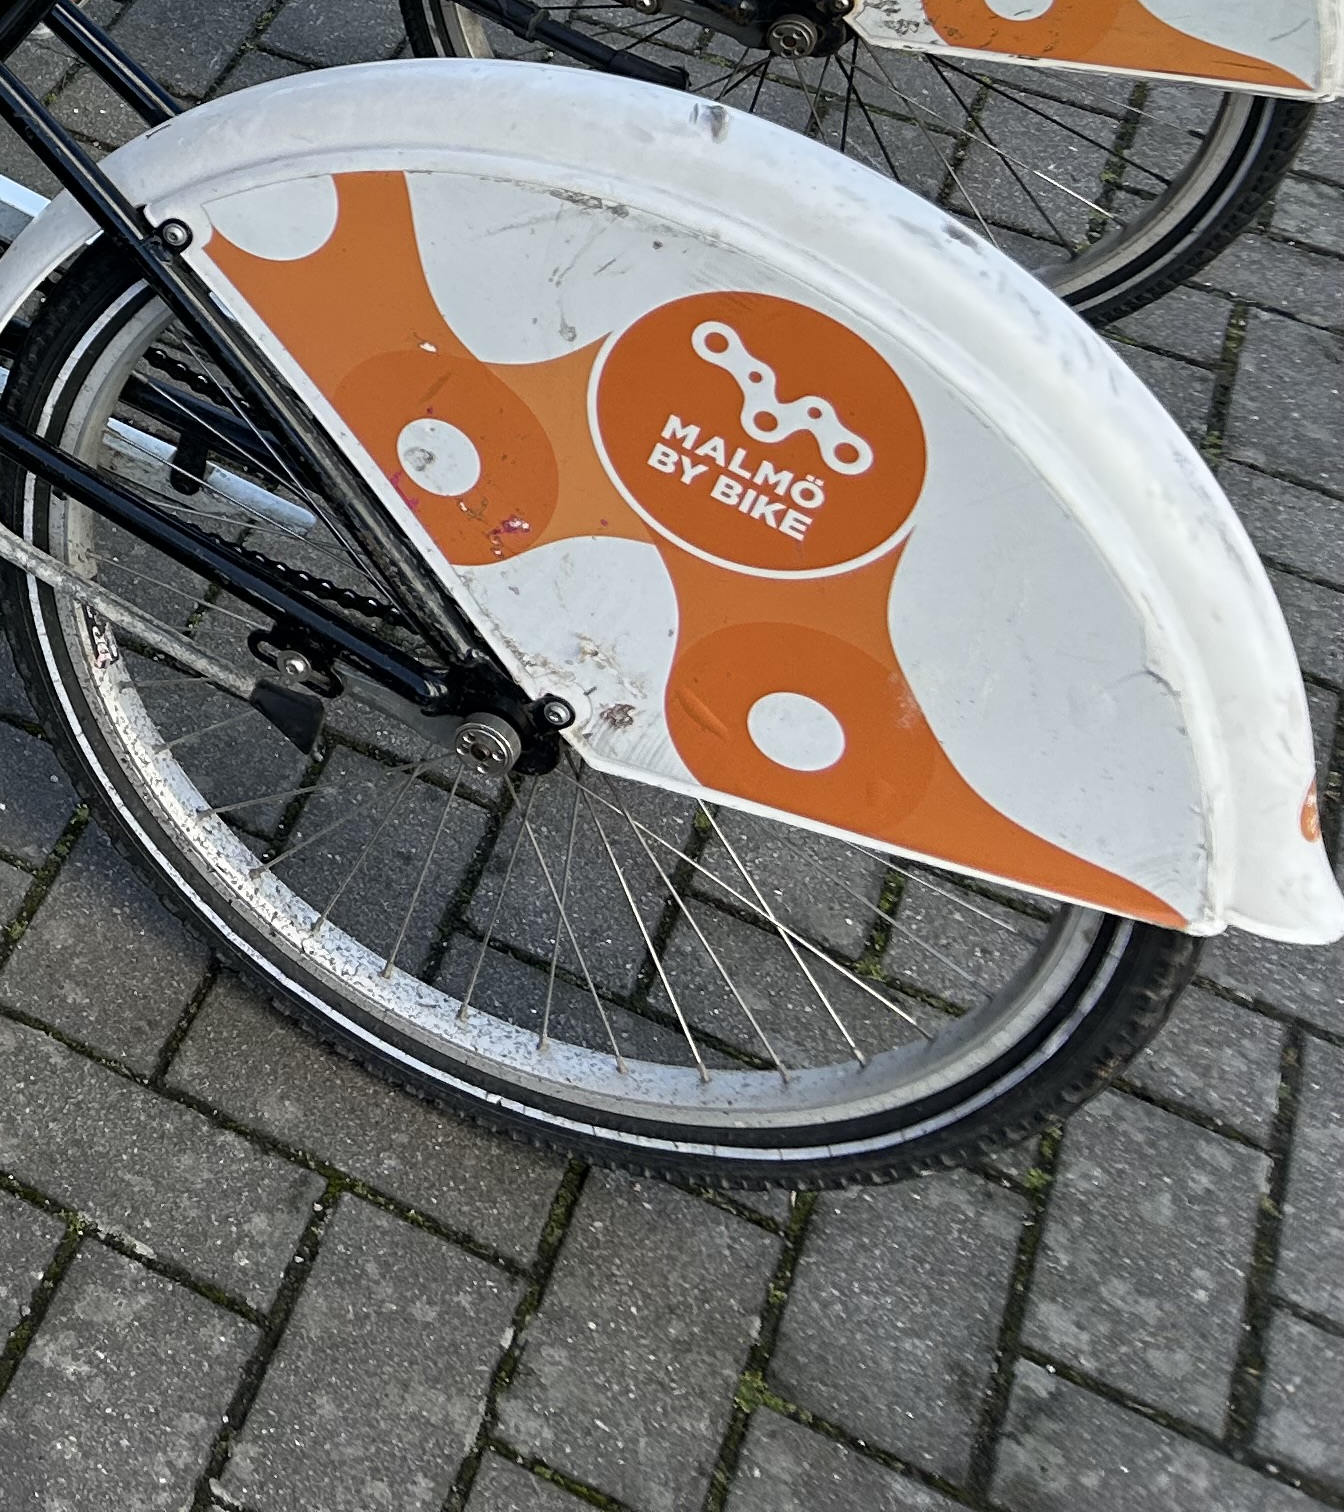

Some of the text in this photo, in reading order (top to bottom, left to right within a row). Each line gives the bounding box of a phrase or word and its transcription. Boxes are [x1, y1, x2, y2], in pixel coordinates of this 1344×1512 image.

[646, 442, 814, 542] BY BIKE
[660, 413, 826, 510] MALMÖ
